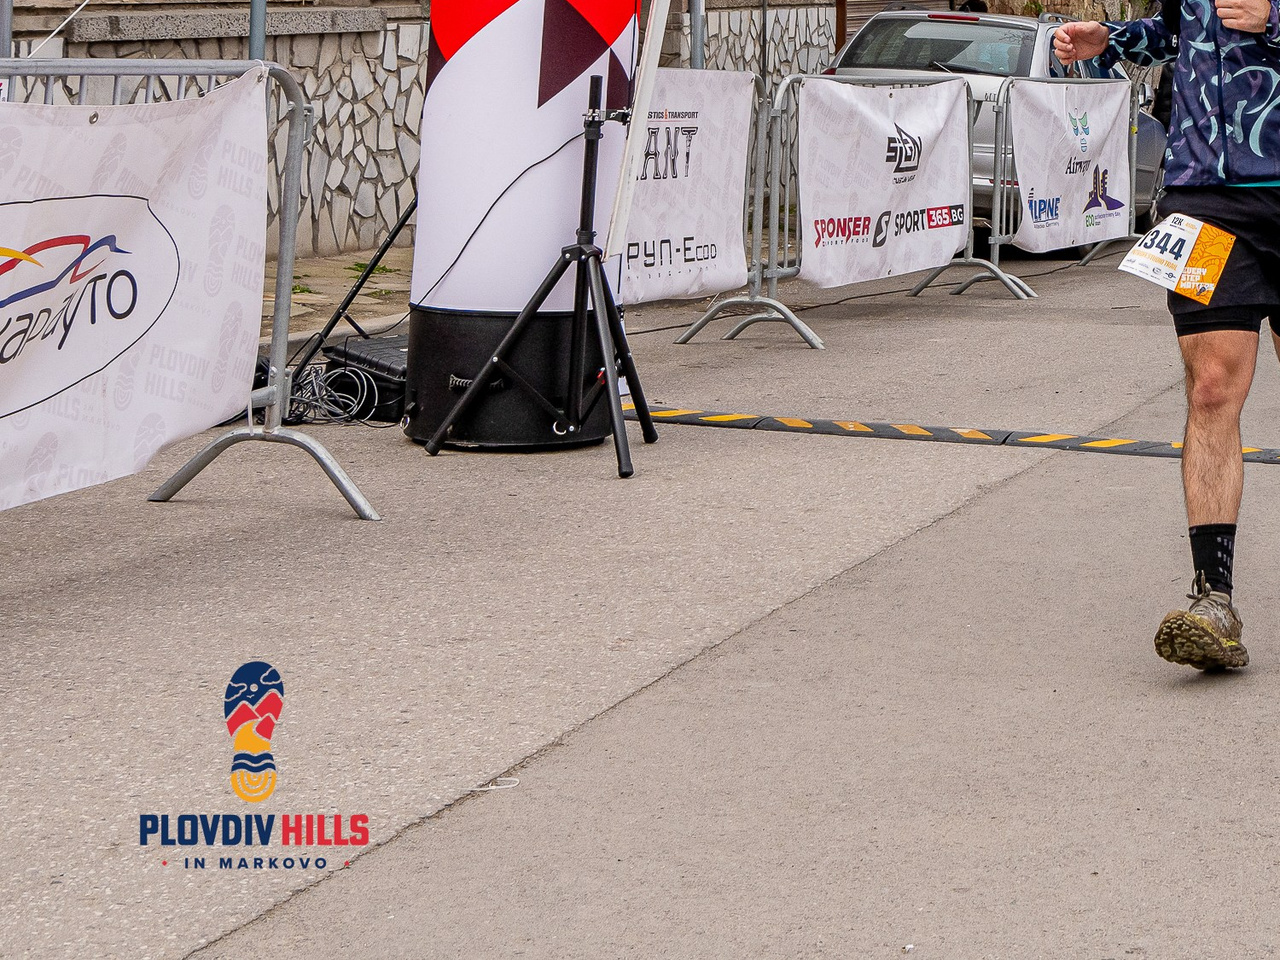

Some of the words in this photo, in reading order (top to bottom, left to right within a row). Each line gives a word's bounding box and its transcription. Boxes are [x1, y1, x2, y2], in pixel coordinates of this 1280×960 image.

[668, 111, 699, 119] TRANSPORT
[635, 126, 699, 180] ANT
[814, 216, 871, 248] SPONSER
